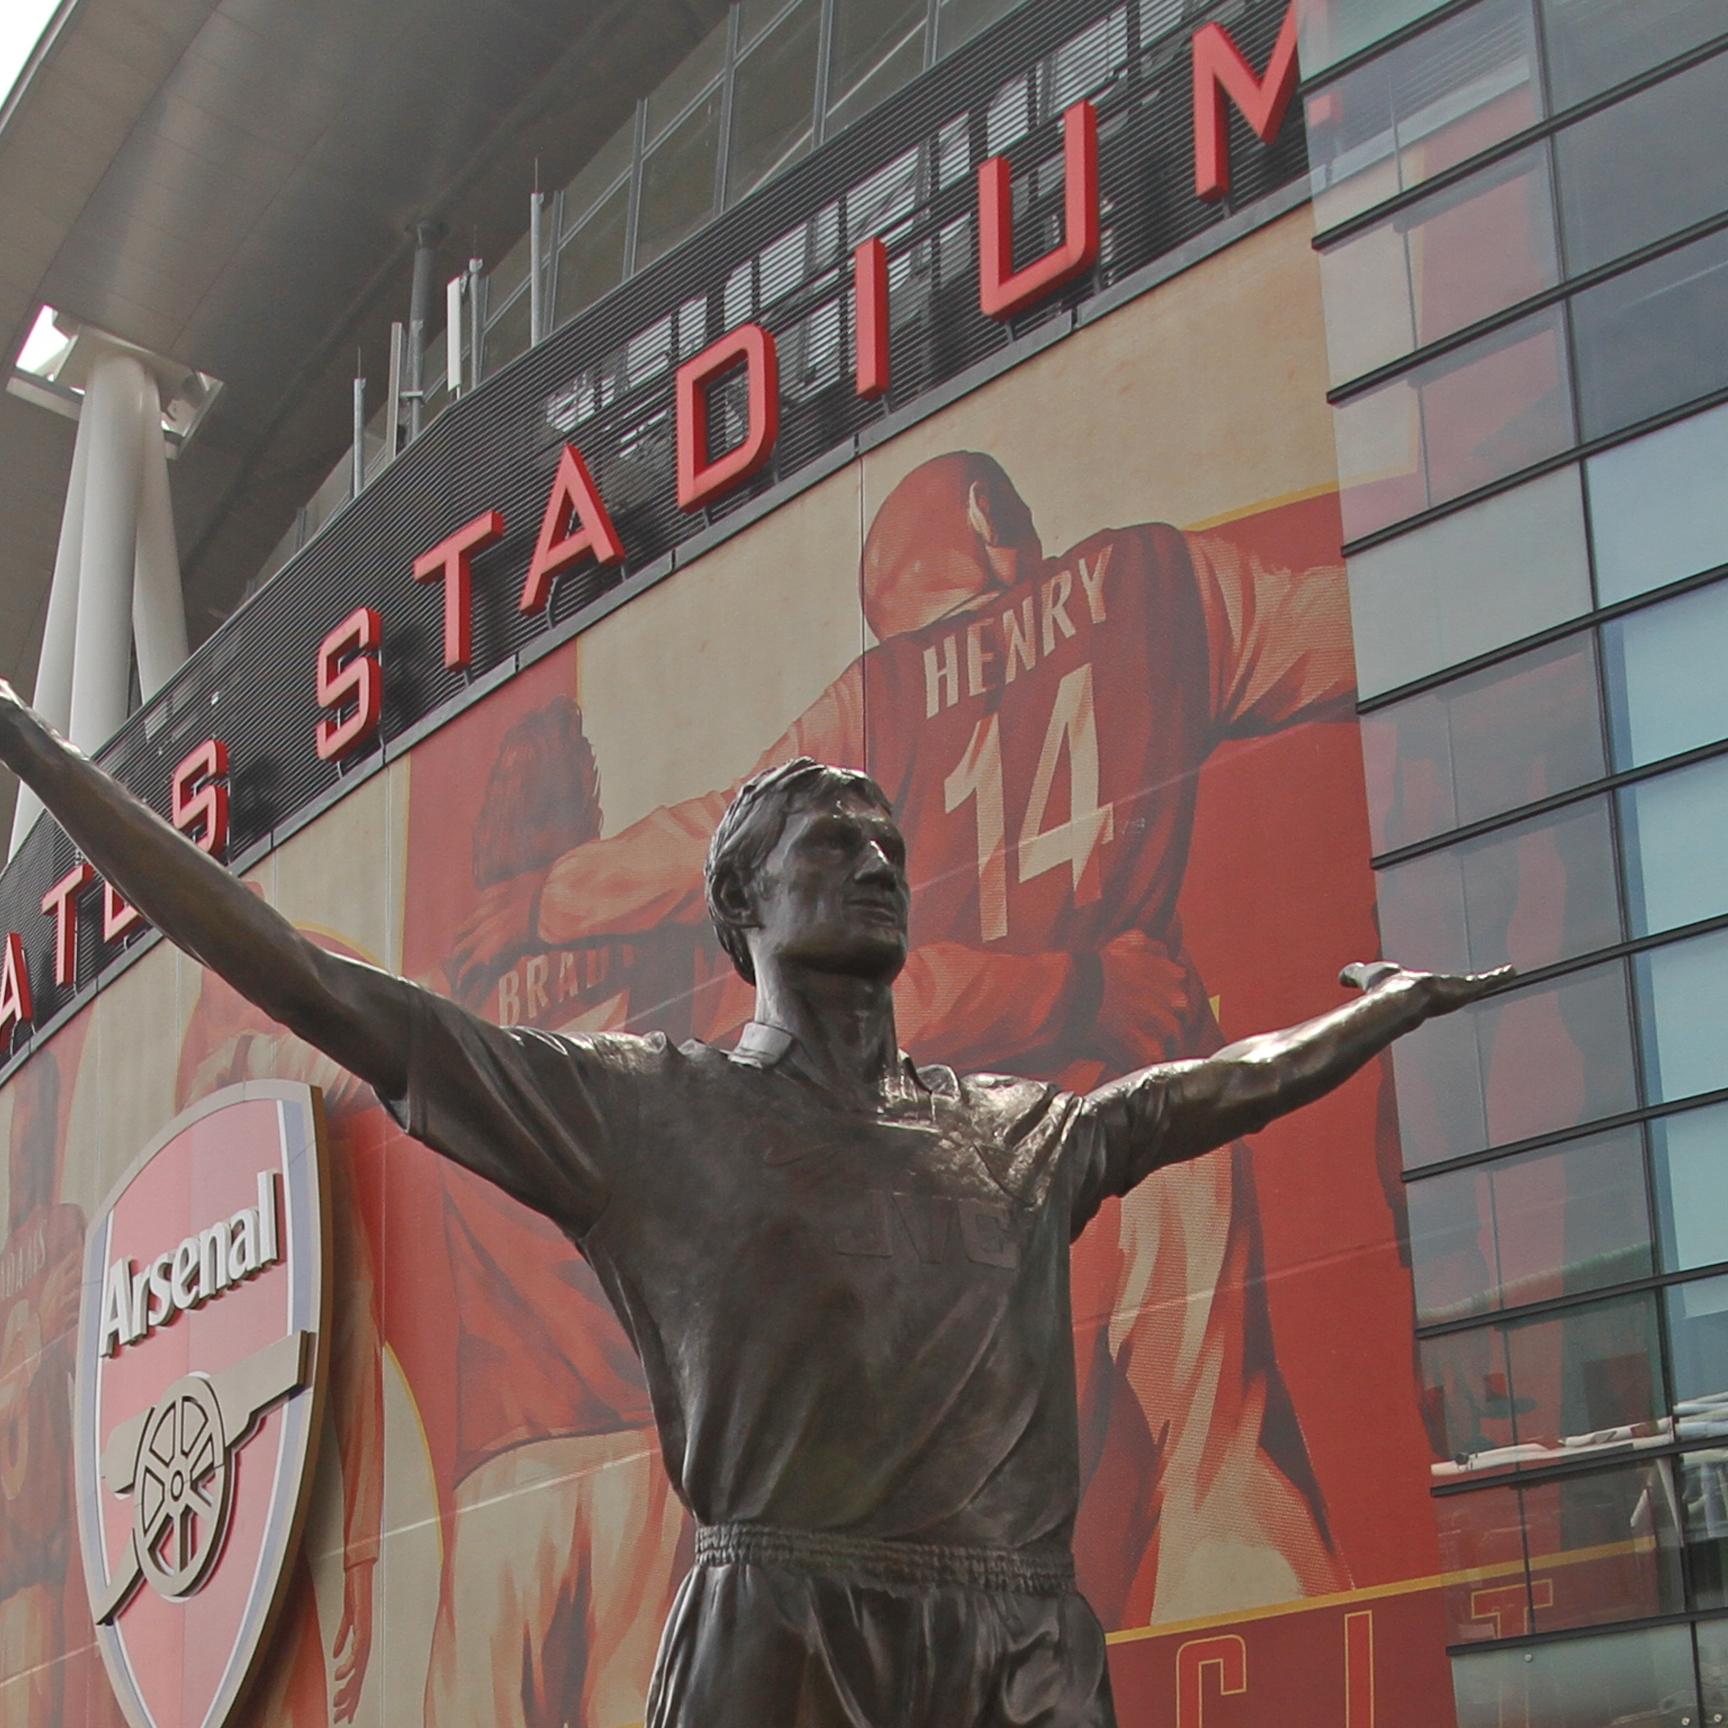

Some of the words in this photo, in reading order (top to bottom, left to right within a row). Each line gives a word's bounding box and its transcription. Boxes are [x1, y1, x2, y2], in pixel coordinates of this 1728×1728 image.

[316, 0, 1299, 762] STADIUM
[923, 544, 1113, 719] HENRY
[945, 663, 1114, 942] 14
[99, 1170, 282, 1358] Arsenal
